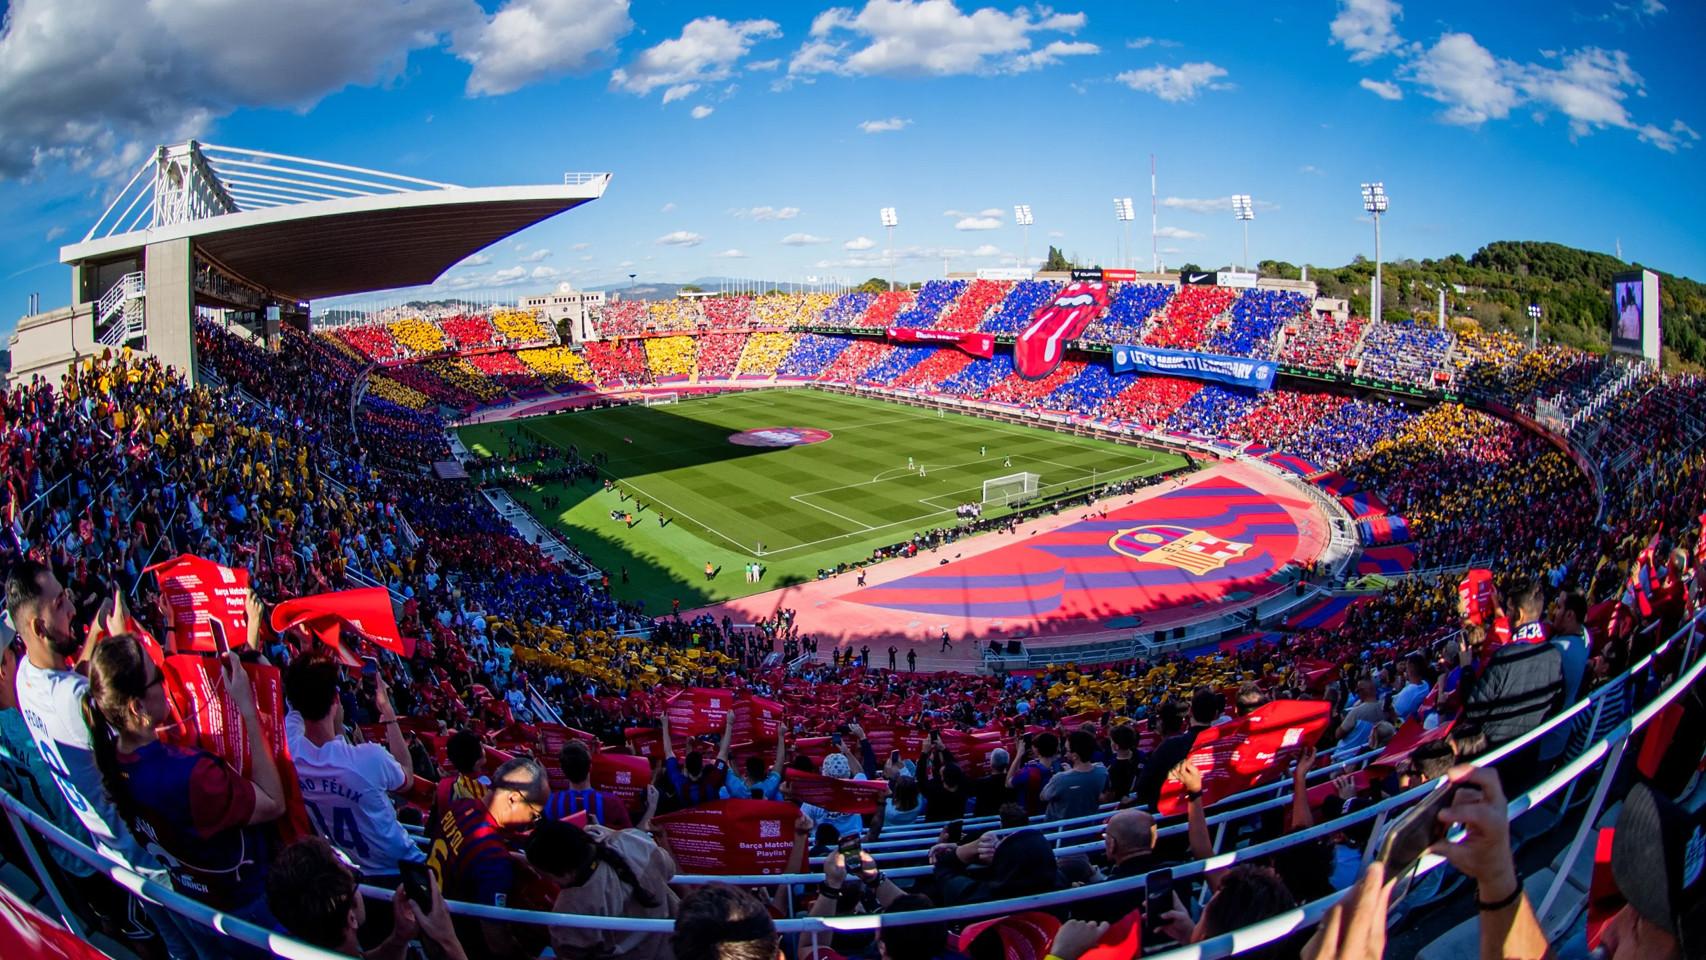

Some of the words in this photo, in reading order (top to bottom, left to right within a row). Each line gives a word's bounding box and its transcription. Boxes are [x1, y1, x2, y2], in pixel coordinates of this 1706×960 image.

[1130, 350, 1157, 367] LET'S
[1187, 357, 1198, 370] IT
[322, 777, 363, 803] FÉLIX
[440, 810, 464, 856] PUYOL
[739, 842, 762, 851] Barça
